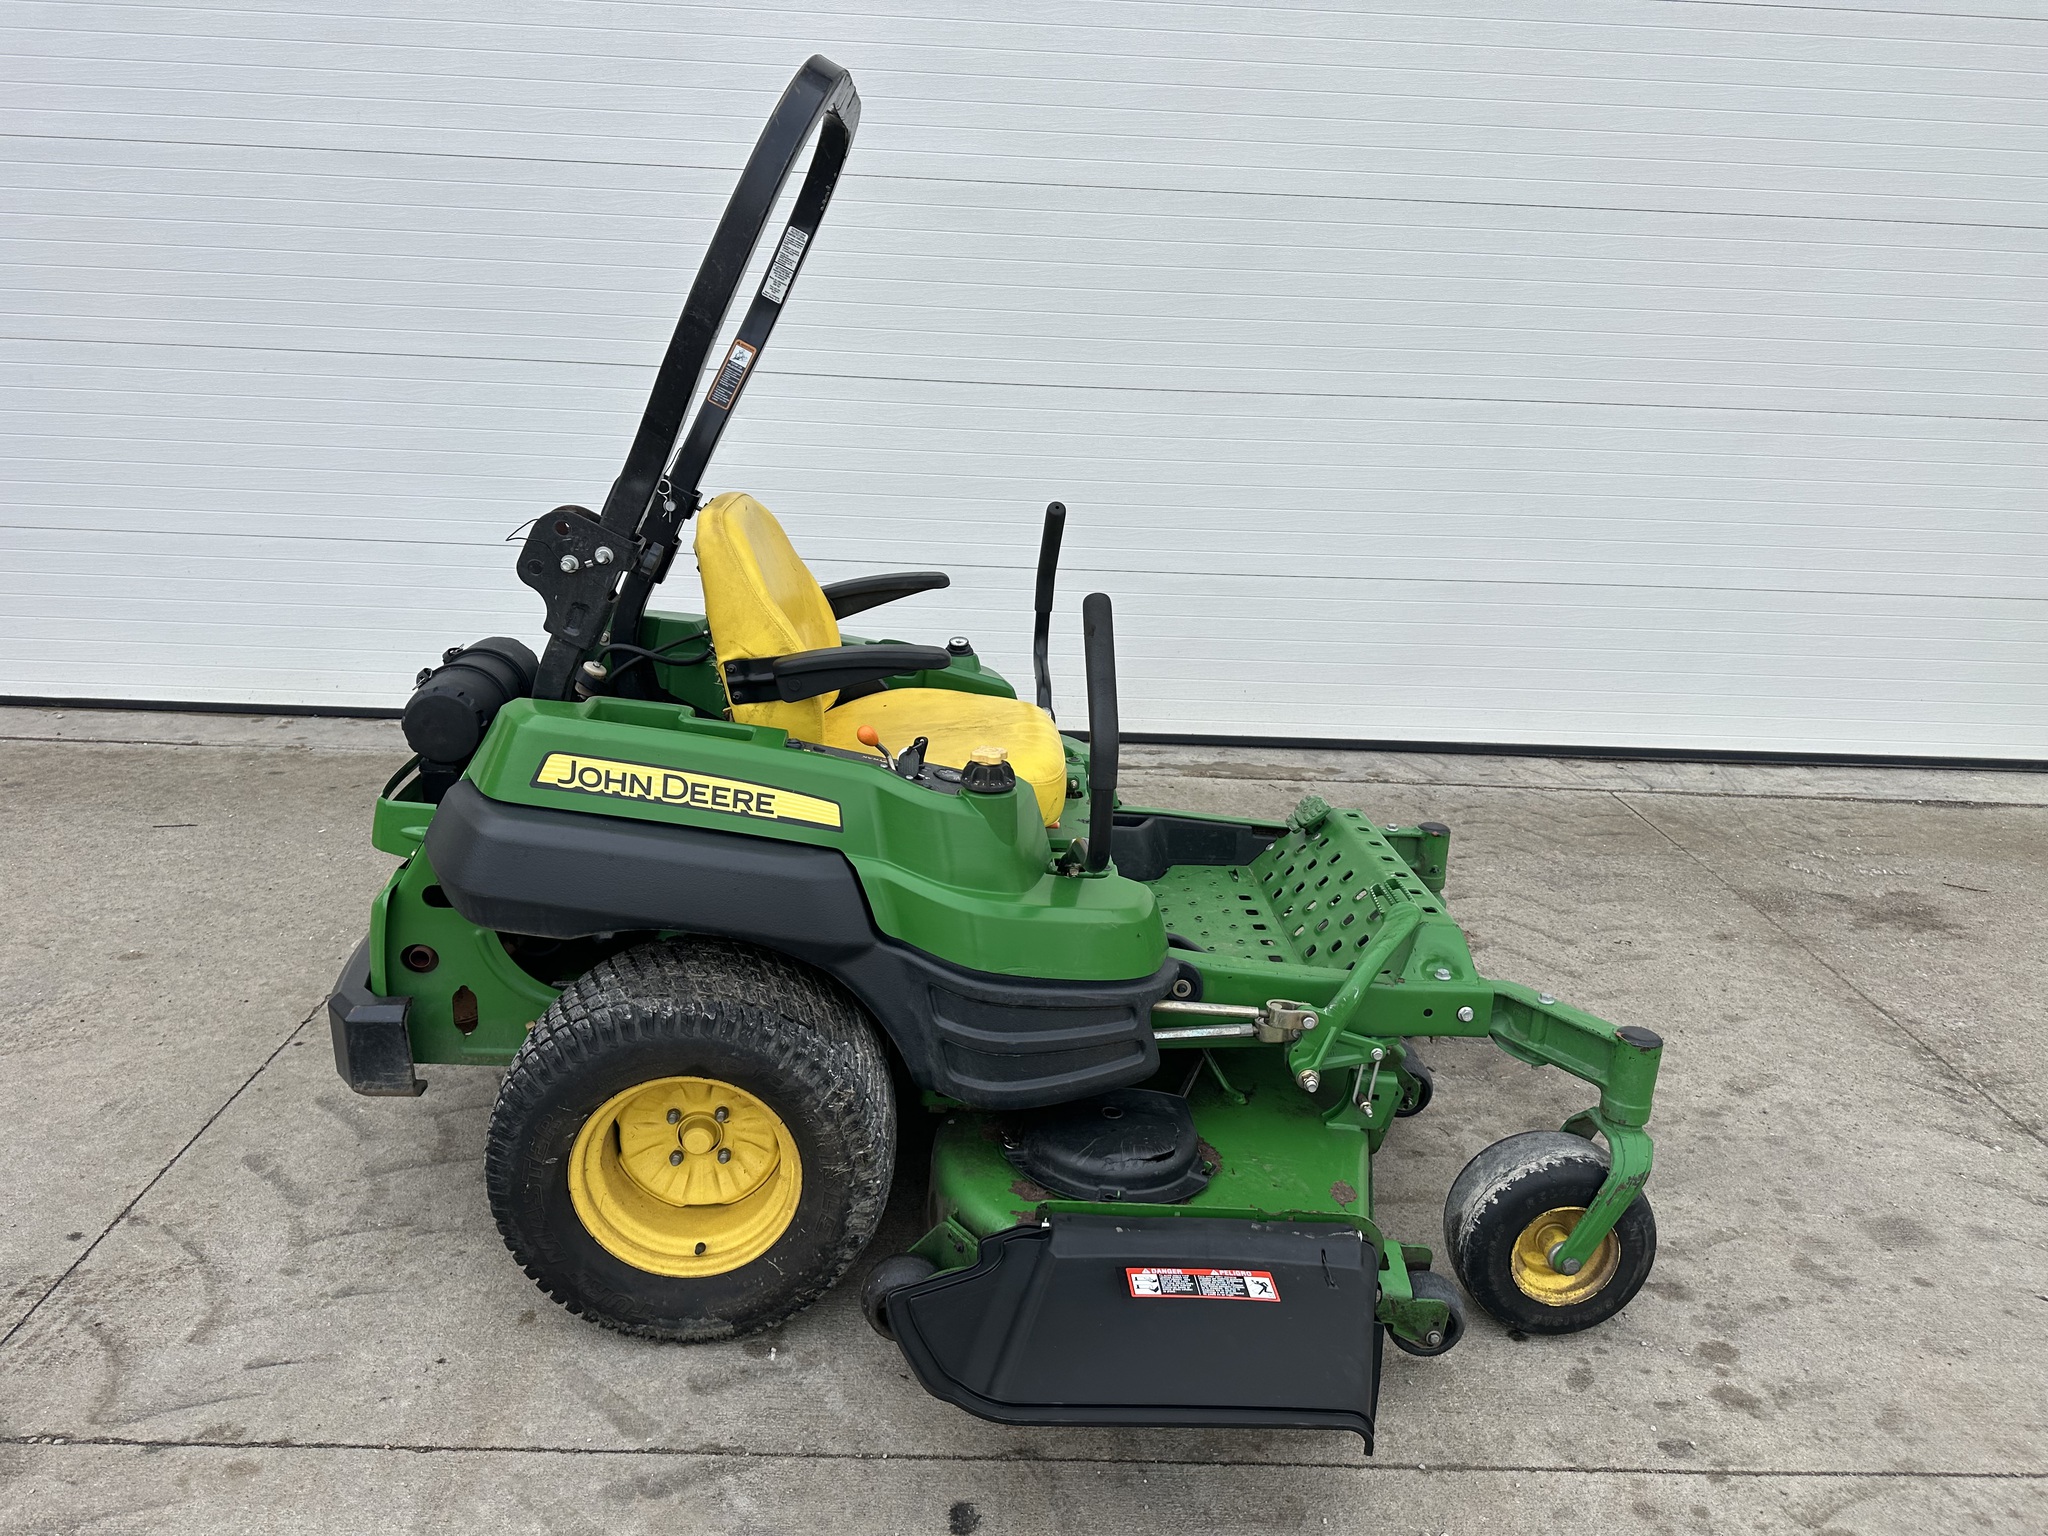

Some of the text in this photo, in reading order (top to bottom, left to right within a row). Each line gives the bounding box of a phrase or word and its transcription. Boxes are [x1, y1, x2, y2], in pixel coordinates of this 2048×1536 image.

[557, 760, 776, 815] JOHN DEERE
[520, 1113, 568, 1265] MASTER
[1219, 1269, 1252, 1277] PELIGRO
